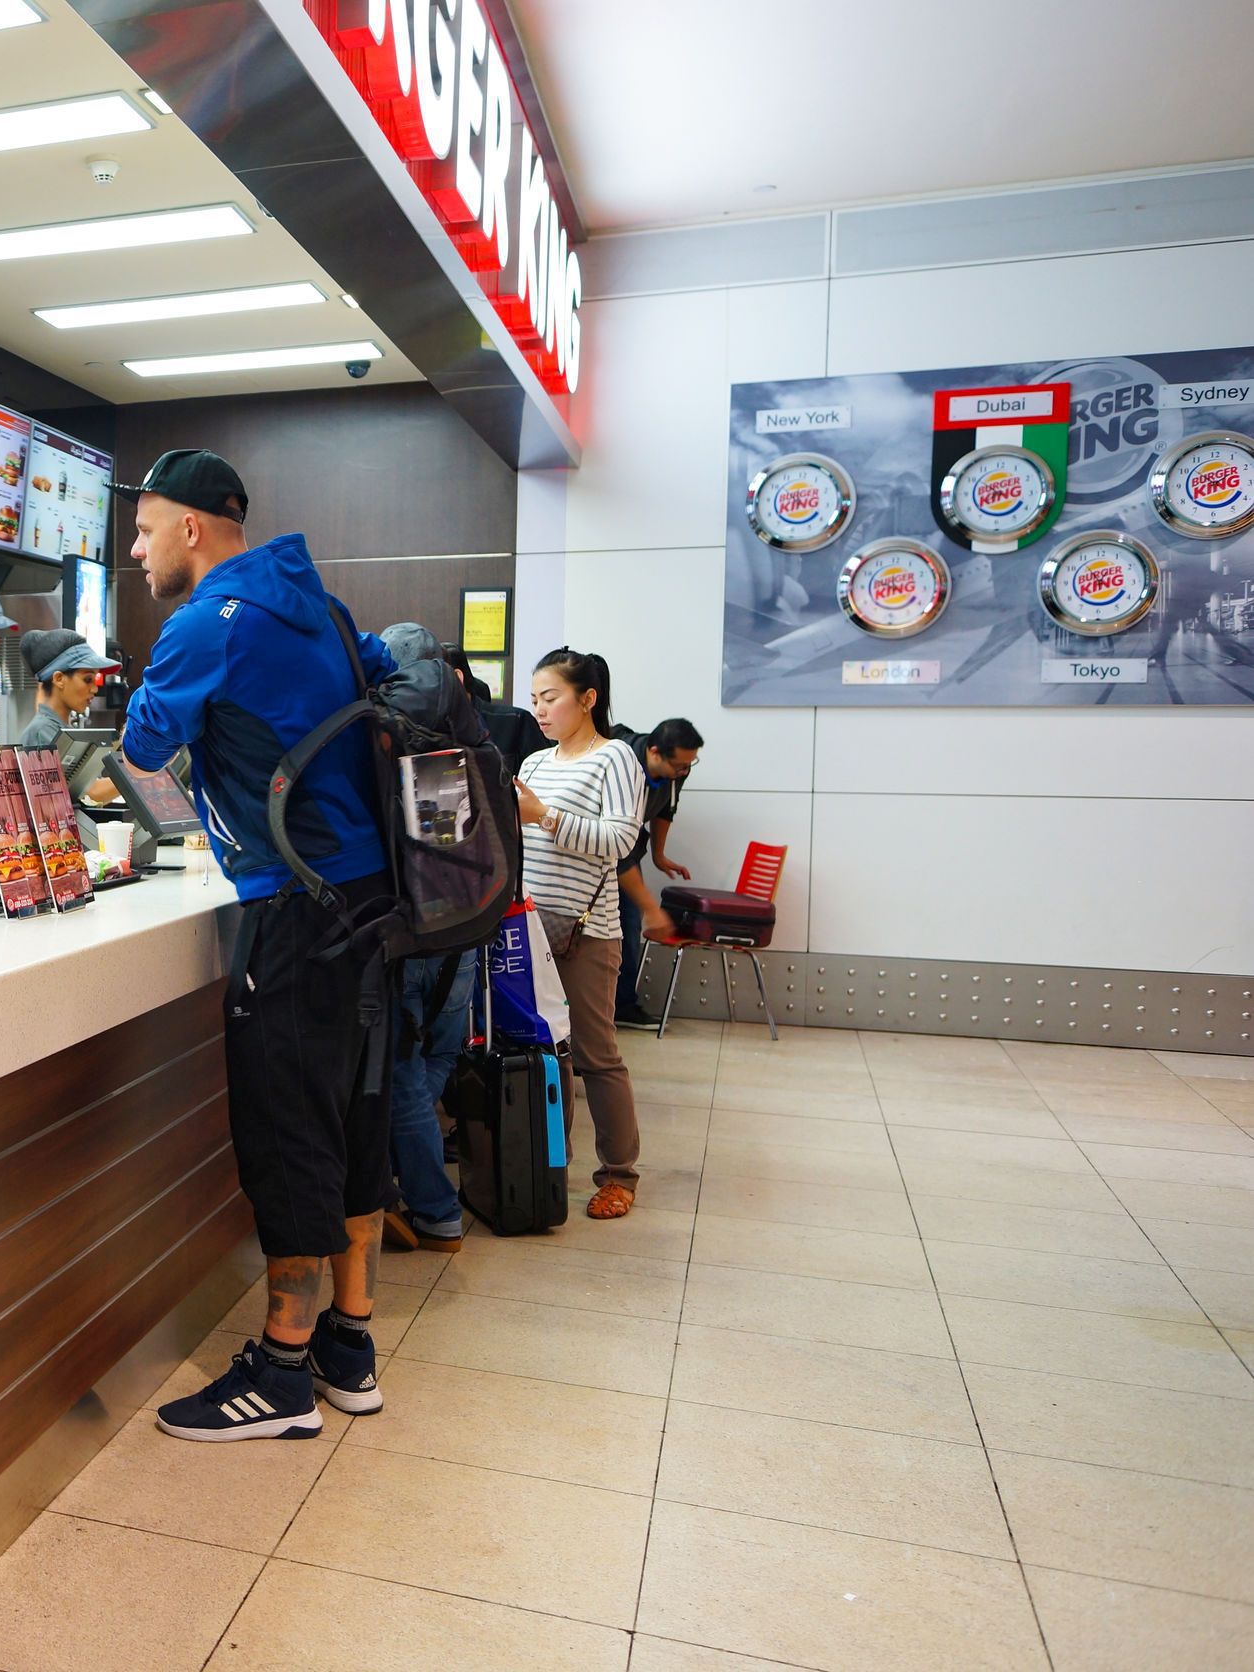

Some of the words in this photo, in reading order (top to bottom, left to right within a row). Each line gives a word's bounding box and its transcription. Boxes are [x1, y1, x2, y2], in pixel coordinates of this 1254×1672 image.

[516, 126, 582, 394] KING
[1180, 386, 1250, 404] Sydney
[976, 397, 1026, 414] Dubai
[1070, 383, 1154, 426] RGER
[766, 414, 801, 427] New
[805, 411, 840, 425] York
[1068, 408, 1160, 466] ING
[1192, 466, 1238, 487] BURGER
[779, 488, 819, 502] BURGER
[978, 477, 1021, 496] BURGER
[1193, 475, 1240, 500] KING
[778, 497, 820, 514] KING
[980, 486, 1022, 508] KING
[874, 573, 915, 589] BURGER
[1078, 566, 1123, 584] BURGER
[875, 581, 915, 600] KING
[1080, 575, 1124, 597] KING
[860, 664, 921, 679] London
[1069, 663, 1121, 680] Tokyo
